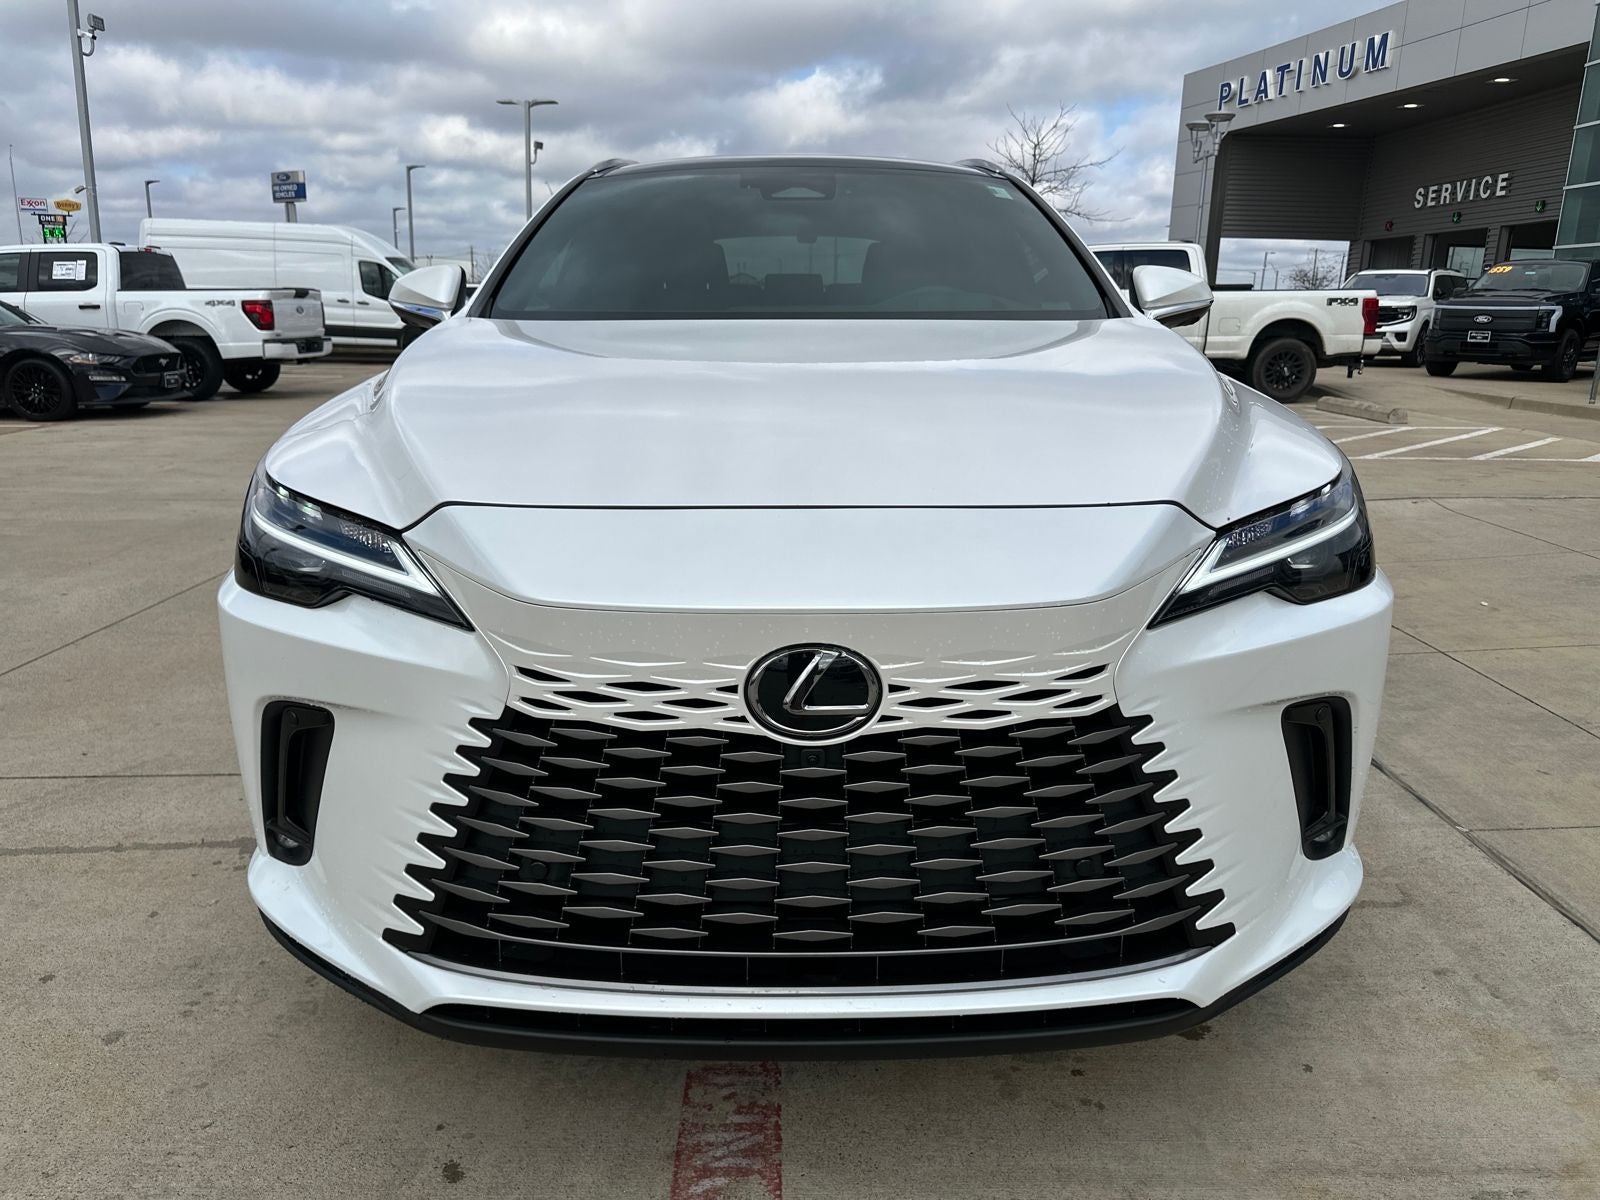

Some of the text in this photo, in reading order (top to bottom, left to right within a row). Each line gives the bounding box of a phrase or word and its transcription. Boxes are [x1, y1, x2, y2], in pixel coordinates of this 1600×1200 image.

[1218, 31, 1392, 111] PLATINUM
[20, 199, 46, 208] Exxon
[1414, 173, 1509, 208] SERVICE
